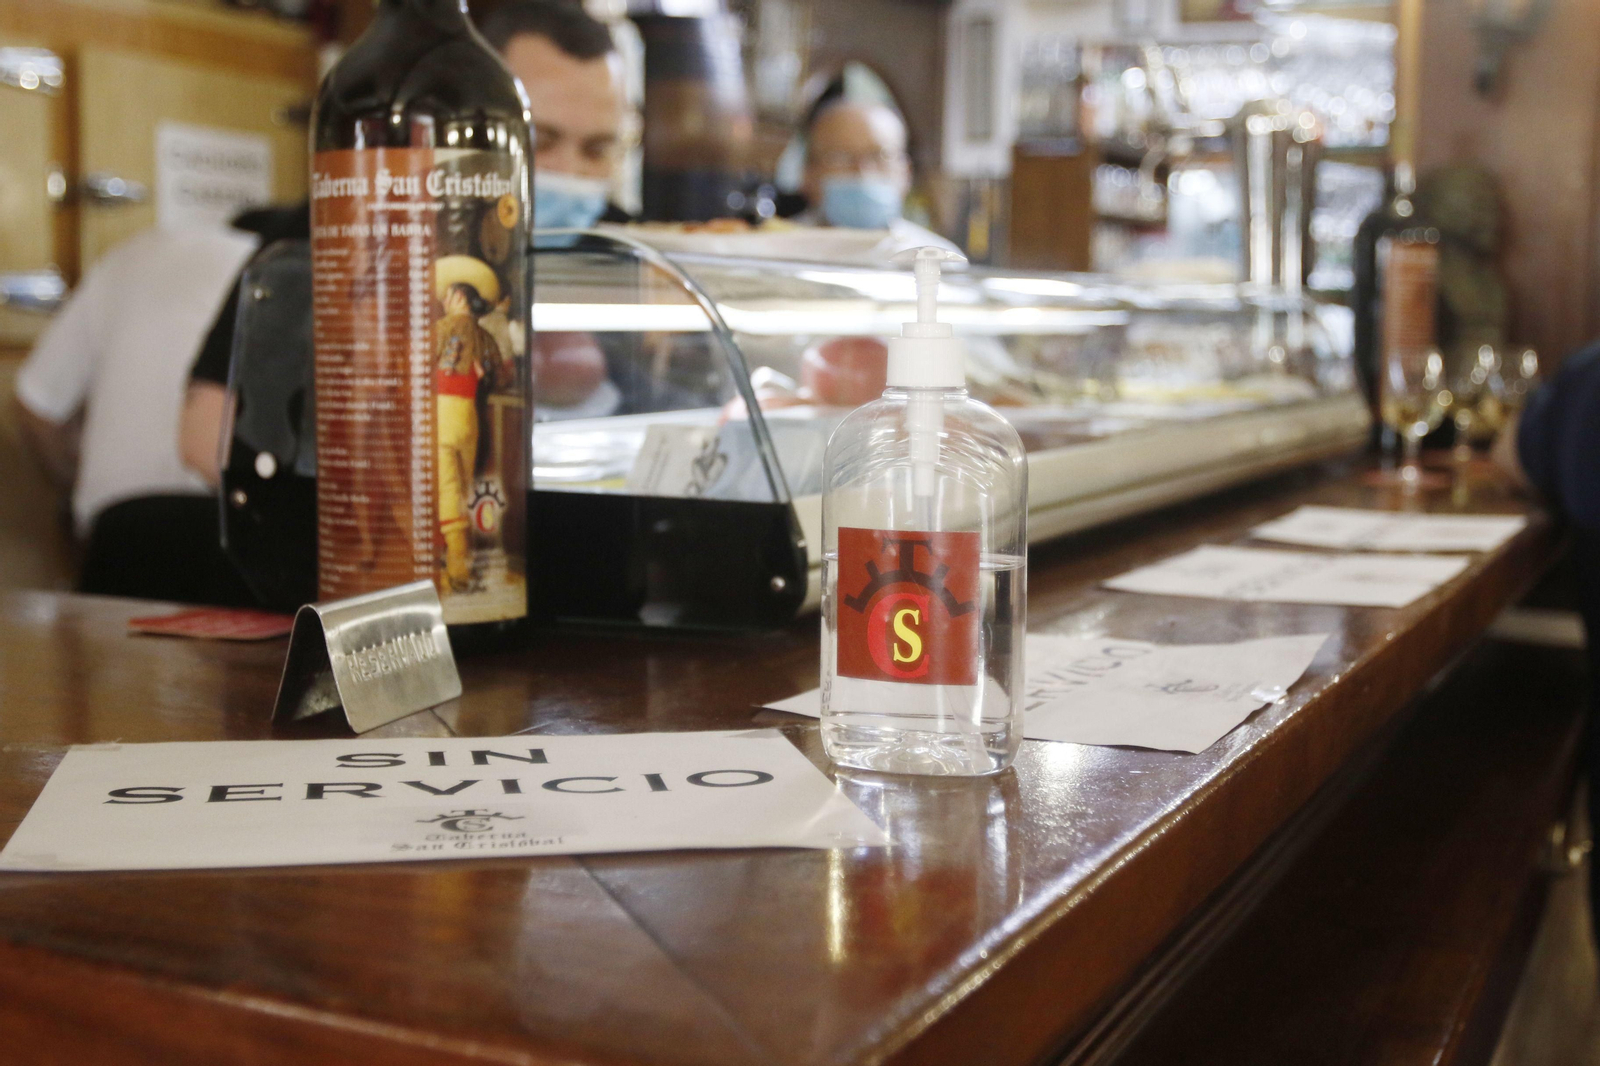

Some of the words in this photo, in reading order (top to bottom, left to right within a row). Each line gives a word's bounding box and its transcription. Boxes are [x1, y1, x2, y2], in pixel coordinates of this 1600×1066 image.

[375, 168, 420, 197] San
[336, 748, 550, 768] SIN
[103, 769, 775, 804] SERVICIO
[425, 832, 526, 842] Taberna
[391, 843, 444, 852] San
